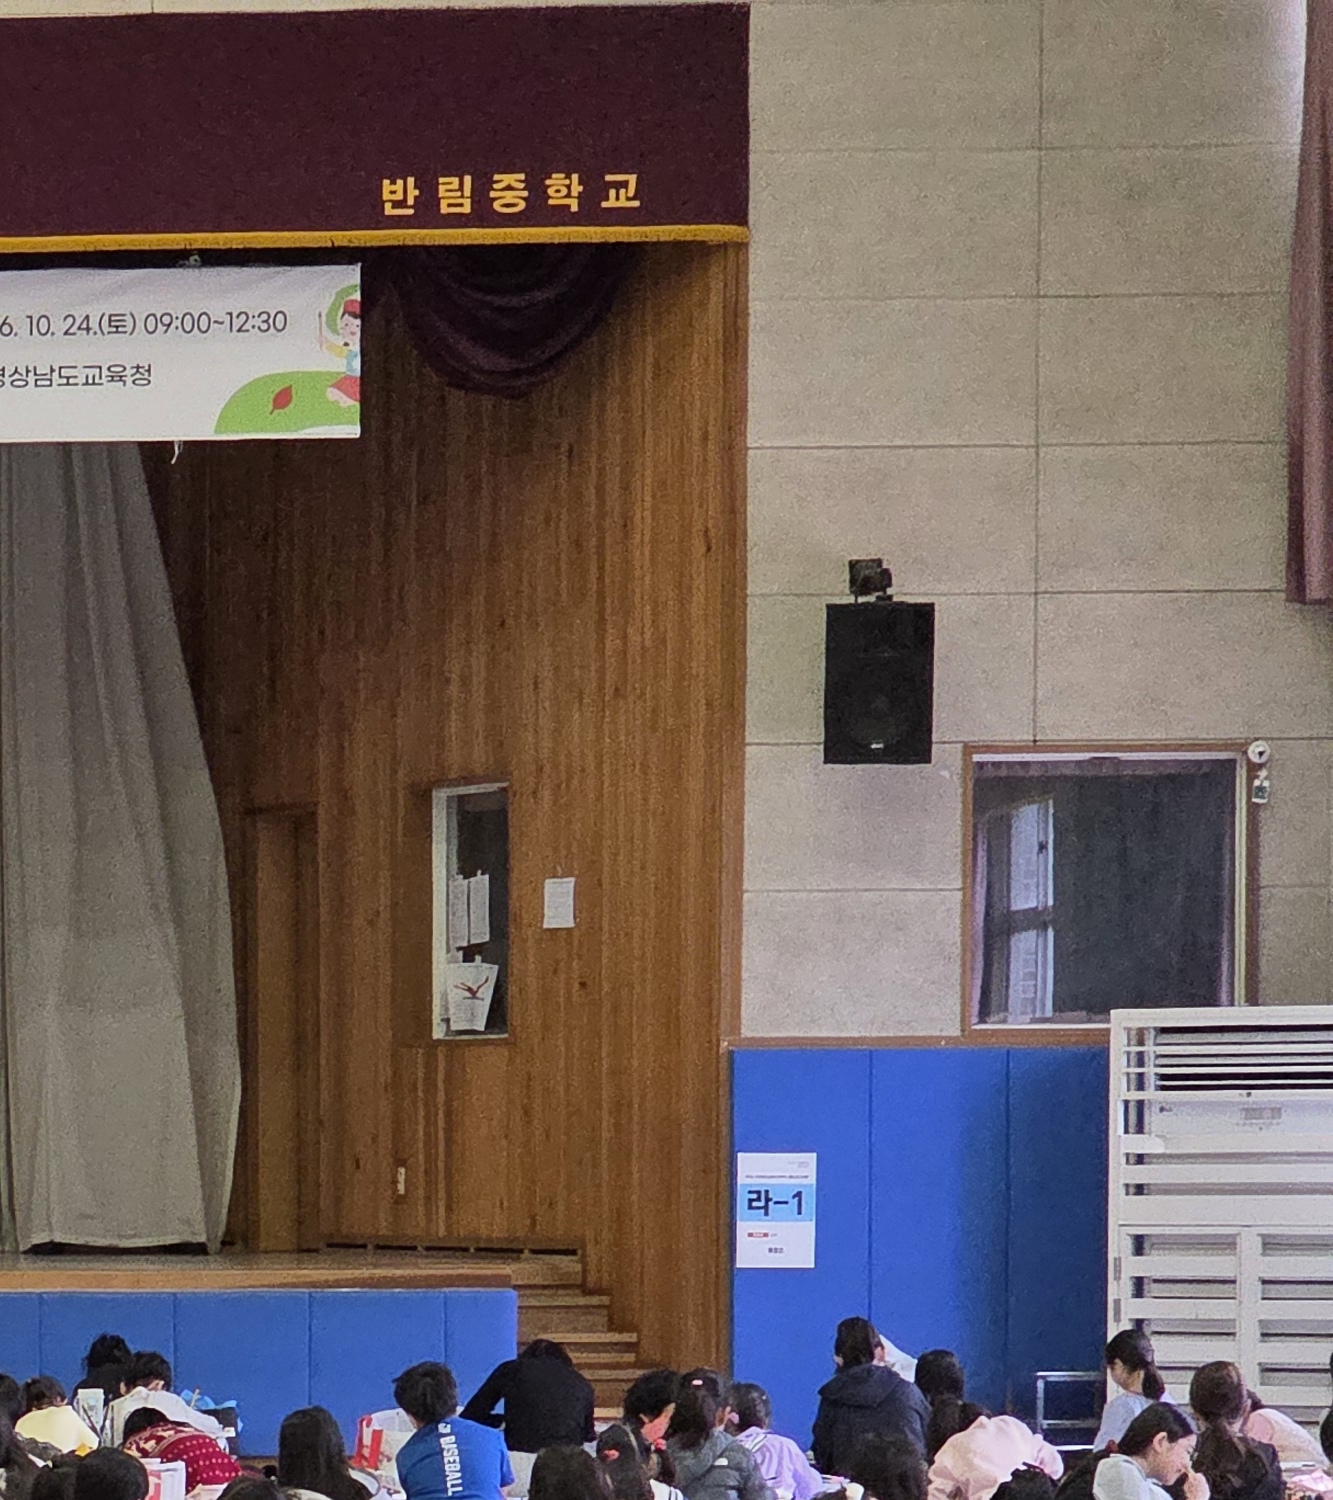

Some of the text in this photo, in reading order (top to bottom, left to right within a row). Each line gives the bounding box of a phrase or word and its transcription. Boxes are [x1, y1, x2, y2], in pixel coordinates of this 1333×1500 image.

[382, 173, 641, 215] 반림중학교
[25, 314, 56, 337] 10.
[143, 310, 288, 335] 09:00~12:30
[746, 1189, 804, 1217] 라-1
[440, 1435, 463, 1497] BASEBALL
